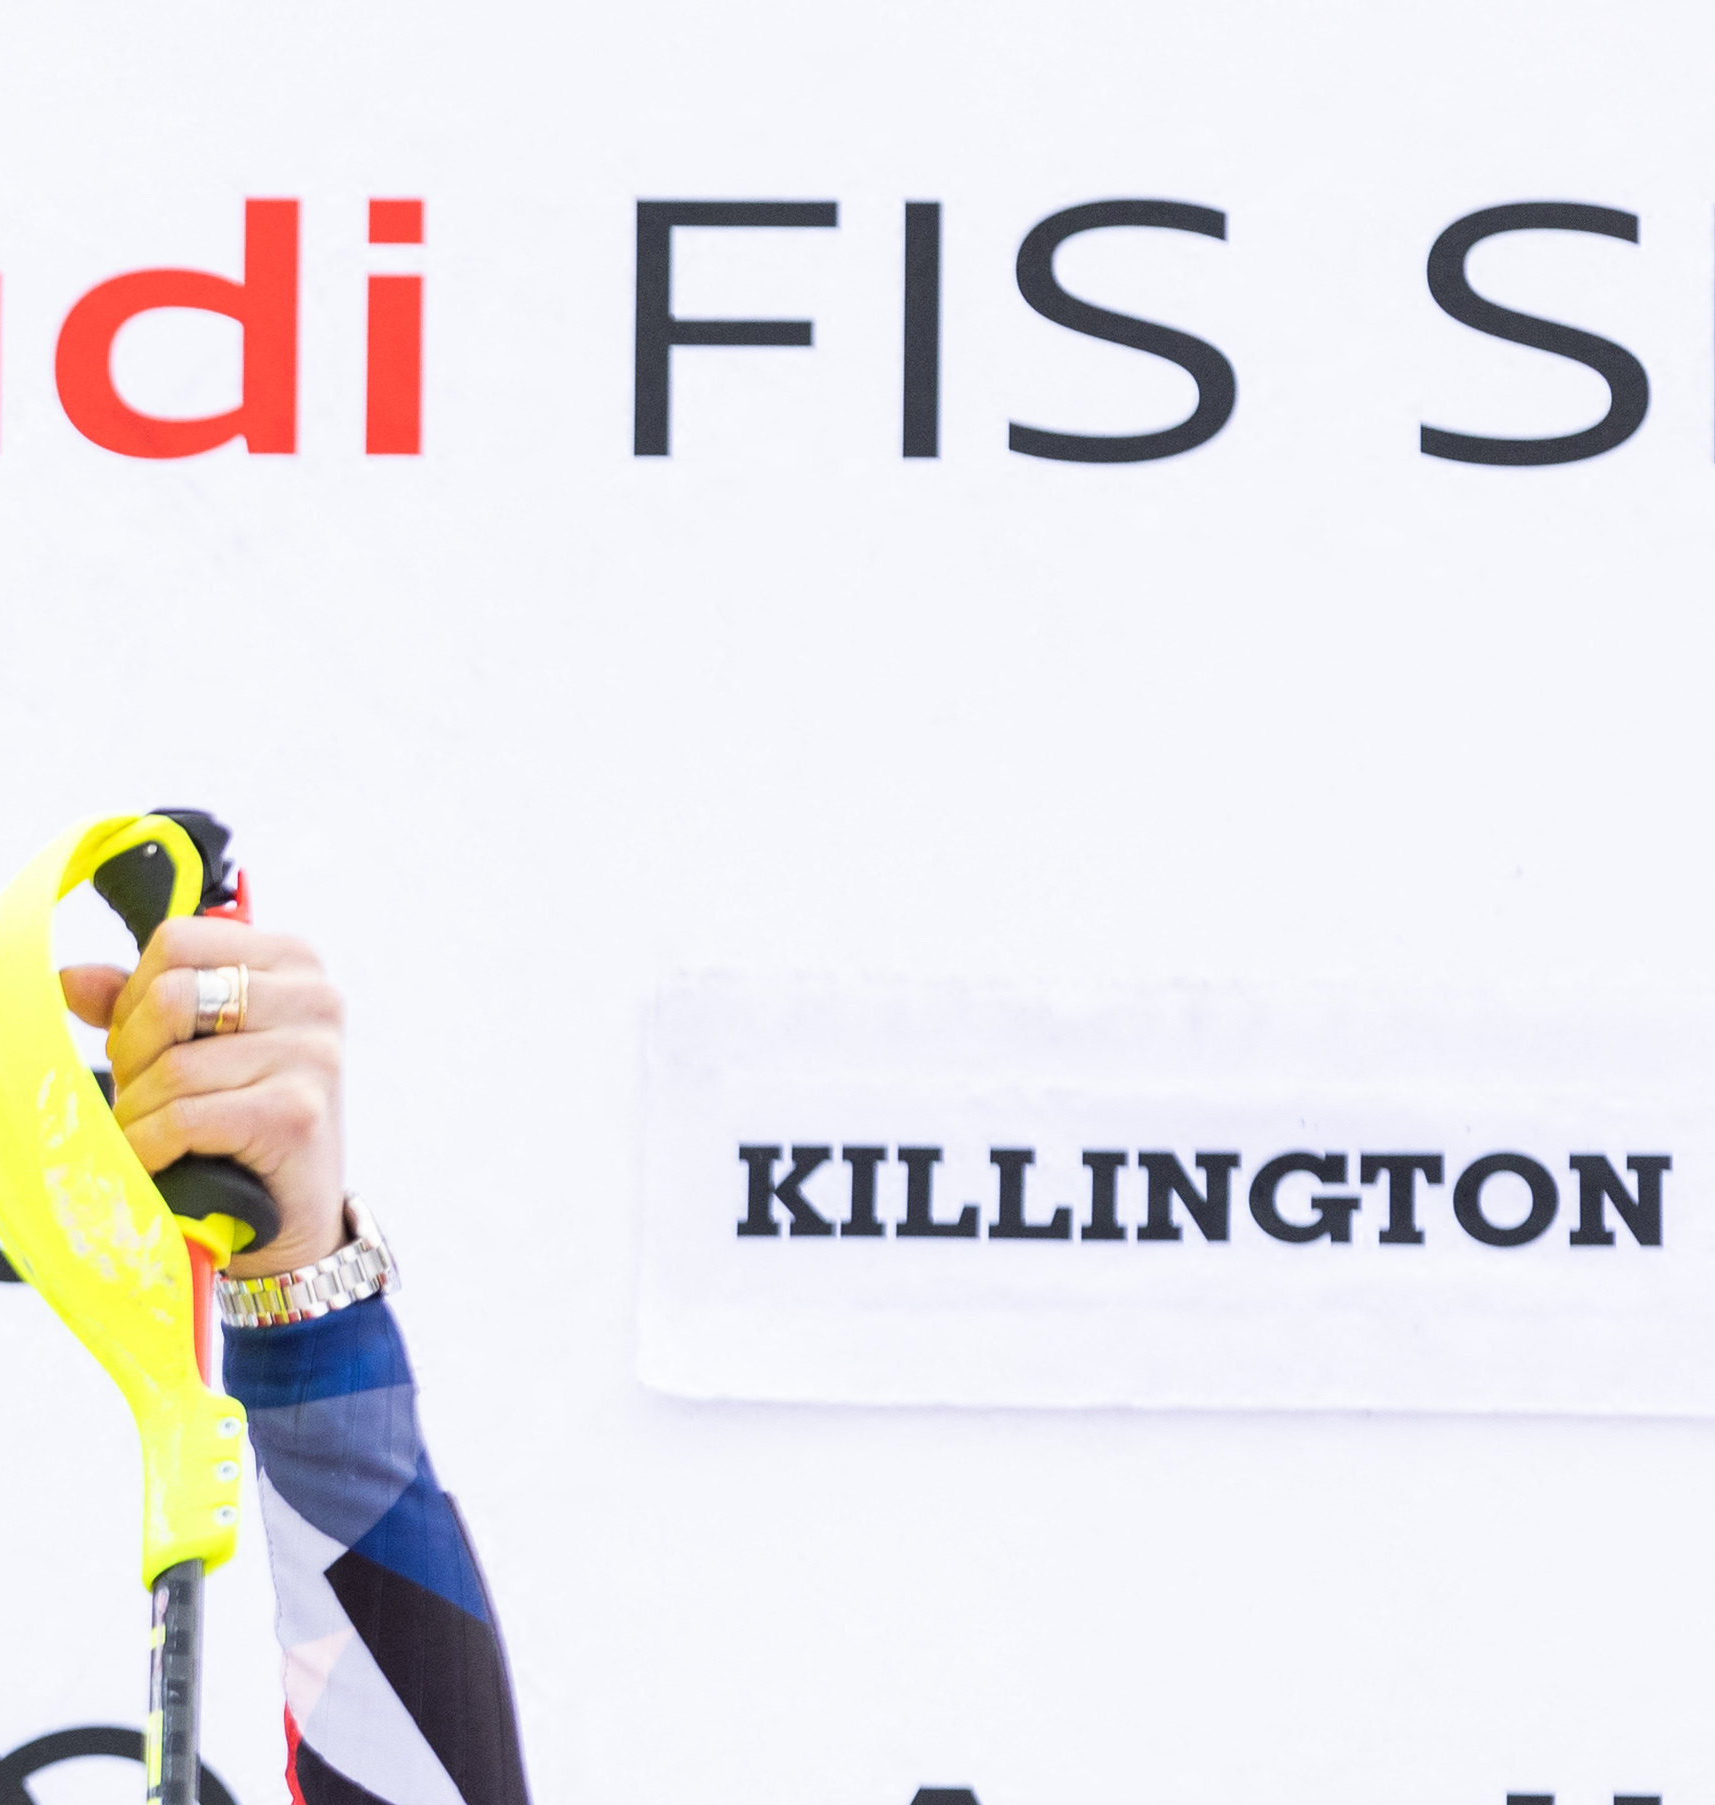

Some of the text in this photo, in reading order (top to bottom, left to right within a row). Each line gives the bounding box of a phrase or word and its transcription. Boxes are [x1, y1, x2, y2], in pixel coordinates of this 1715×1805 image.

[634, 199, 1237, 464] FIS
[1421, 201, 1715, 467] S
[737, 1145, 1672, 1247] KILLINGTON
